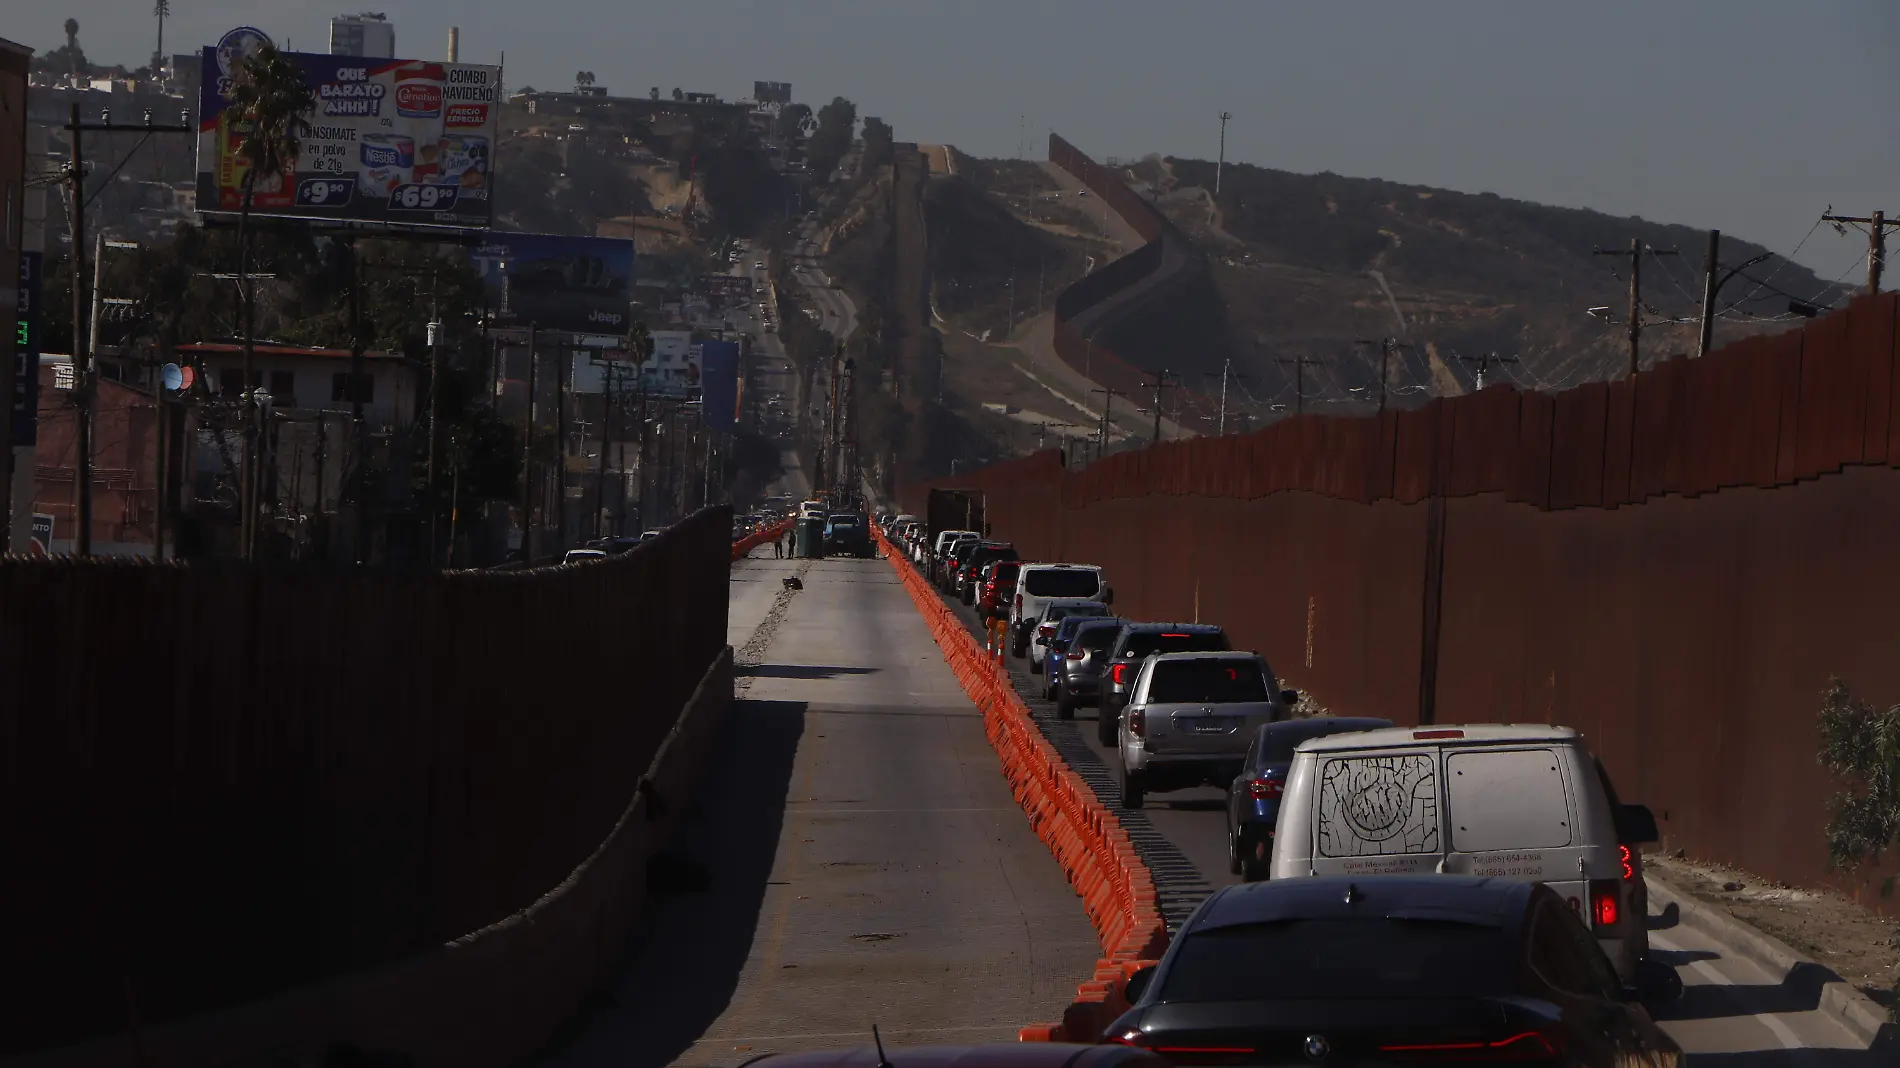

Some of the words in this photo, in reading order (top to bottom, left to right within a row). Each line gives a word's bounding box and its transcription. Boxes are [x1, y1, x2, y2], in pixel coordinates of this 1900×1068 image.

[337, 67, 367, 81] QUE
[450, 69, 487, 84] COMBO
[321, 84, 385, 98] BARATO
[399, 88, 441, 102] Carnation
[442, 86, 493, 102] NAVIDEÑO
[446, 115, 485, 124] ESPECIAL
[301, 126, 357, 141] CONSOMATE
[308, 144, 320, 154] en
[322, 144, 346, 157] polvo
[313, 158, 324, 170] de
[327, 158, 343, 174] 21g
[588, 309, 622, 325] Jeep
